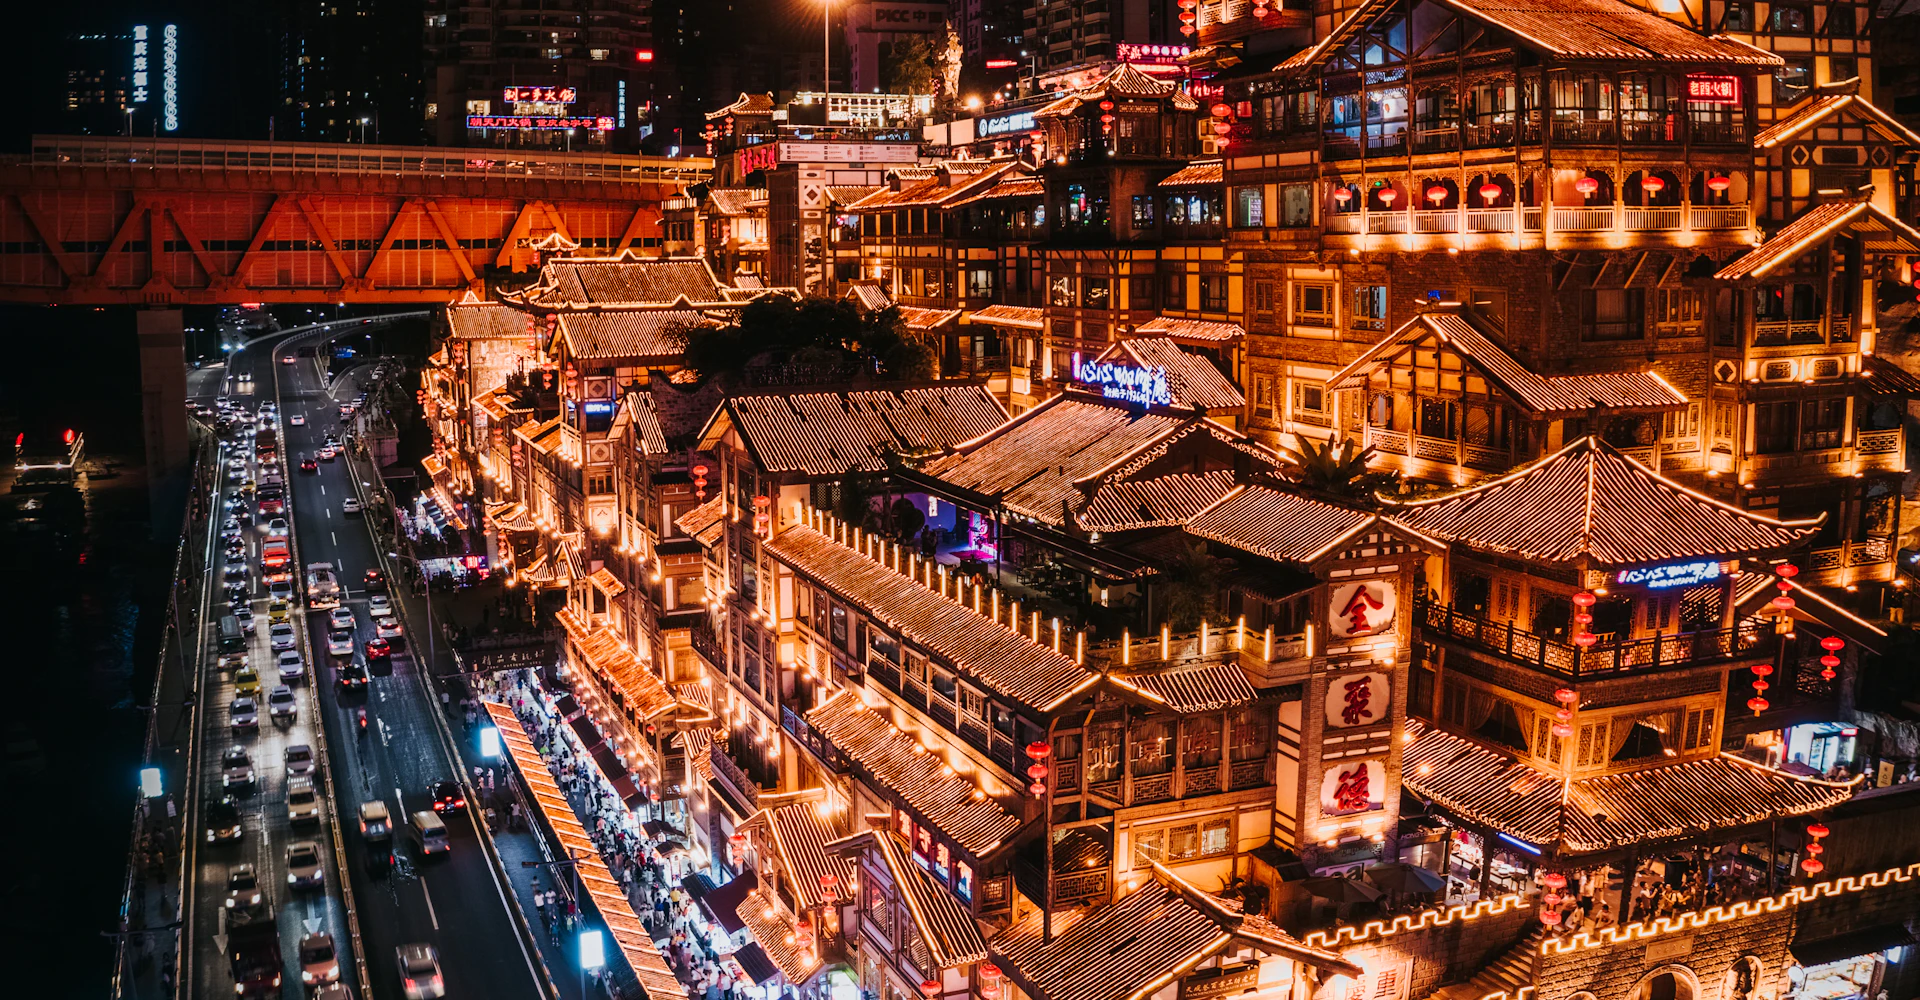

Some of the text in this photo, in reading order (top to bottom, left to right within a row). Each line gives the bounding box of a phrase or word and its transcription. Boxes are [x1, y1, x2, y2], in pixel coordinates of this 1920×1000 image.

[876, 9, 909, 22] PICC
[1334, 585, 1384, 811] 全聚德
